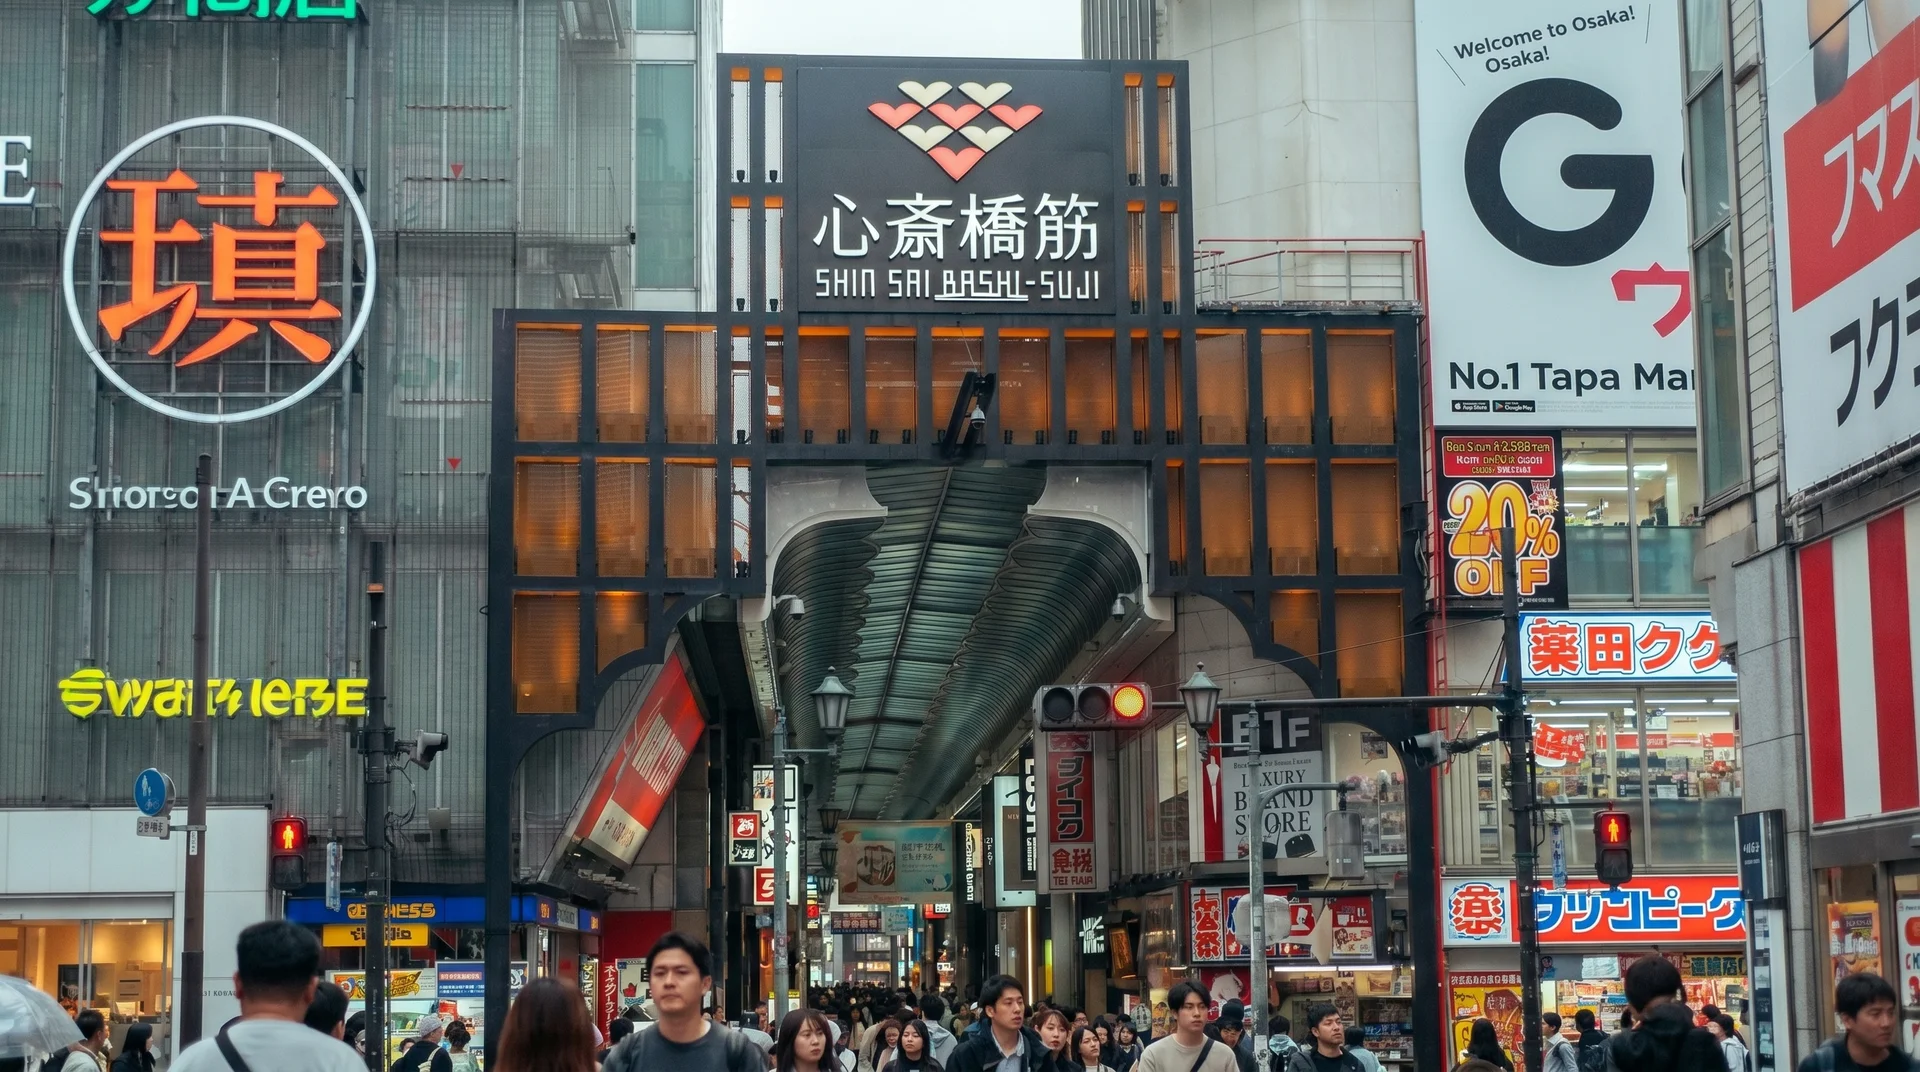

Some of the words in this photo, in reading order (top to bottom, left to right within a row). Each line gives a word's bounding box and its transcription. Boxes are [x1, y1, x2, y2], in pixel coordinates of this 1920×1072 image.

[1454, 27, 1543, 61] Welcome
[1546, 19, 1568, 38] to
[1572, 5, 1636, 33] Osaka!
[1484, 45, 1551, 74] Osaka!
[1464, 77, 1687, 268] G
[813, 192, 1099, 261] 心斎橋筋
[816, 269, 875, 297] SHIN
[888, 269, 930, 298] SAI
[1449, 361, 1520, 391] No.1
[1531, 363, 1620, 396] Tapa
[1242, 769, 1306, 788] LXURY
[1234, 789, 1314, 811] BAND
[1235, 810, 1312, 836] SORE
